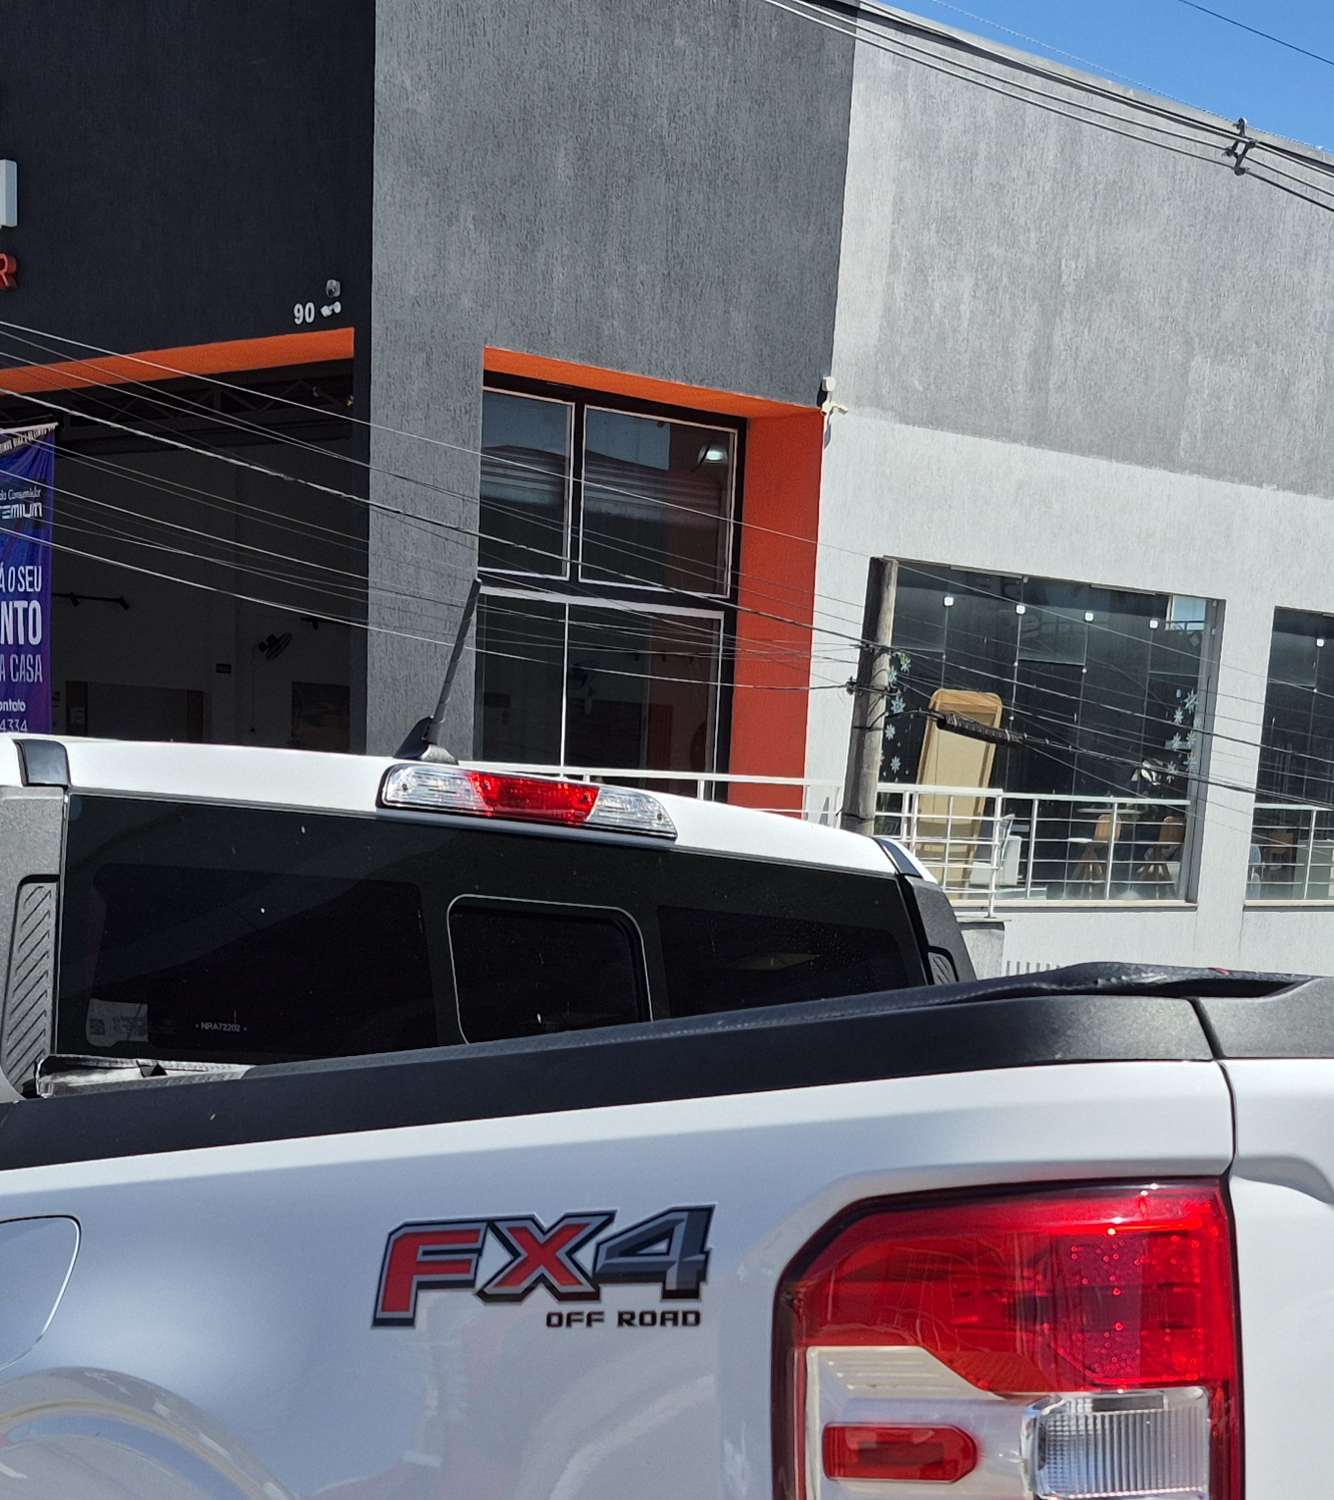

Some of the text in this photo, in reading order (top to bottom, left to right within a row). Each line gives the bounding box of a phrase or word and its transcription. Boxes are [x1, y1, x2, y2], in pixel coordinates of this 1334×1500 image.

[293, 301, 315, 325] 90
[7, 566, 16, 593] O
[17, 565, 42, 593] SEU
[9, 653, 43, 683] CASA
[371, 1203, 717, 1329] FX4
[545, 1309, 702, 1328] OFF ROAD
